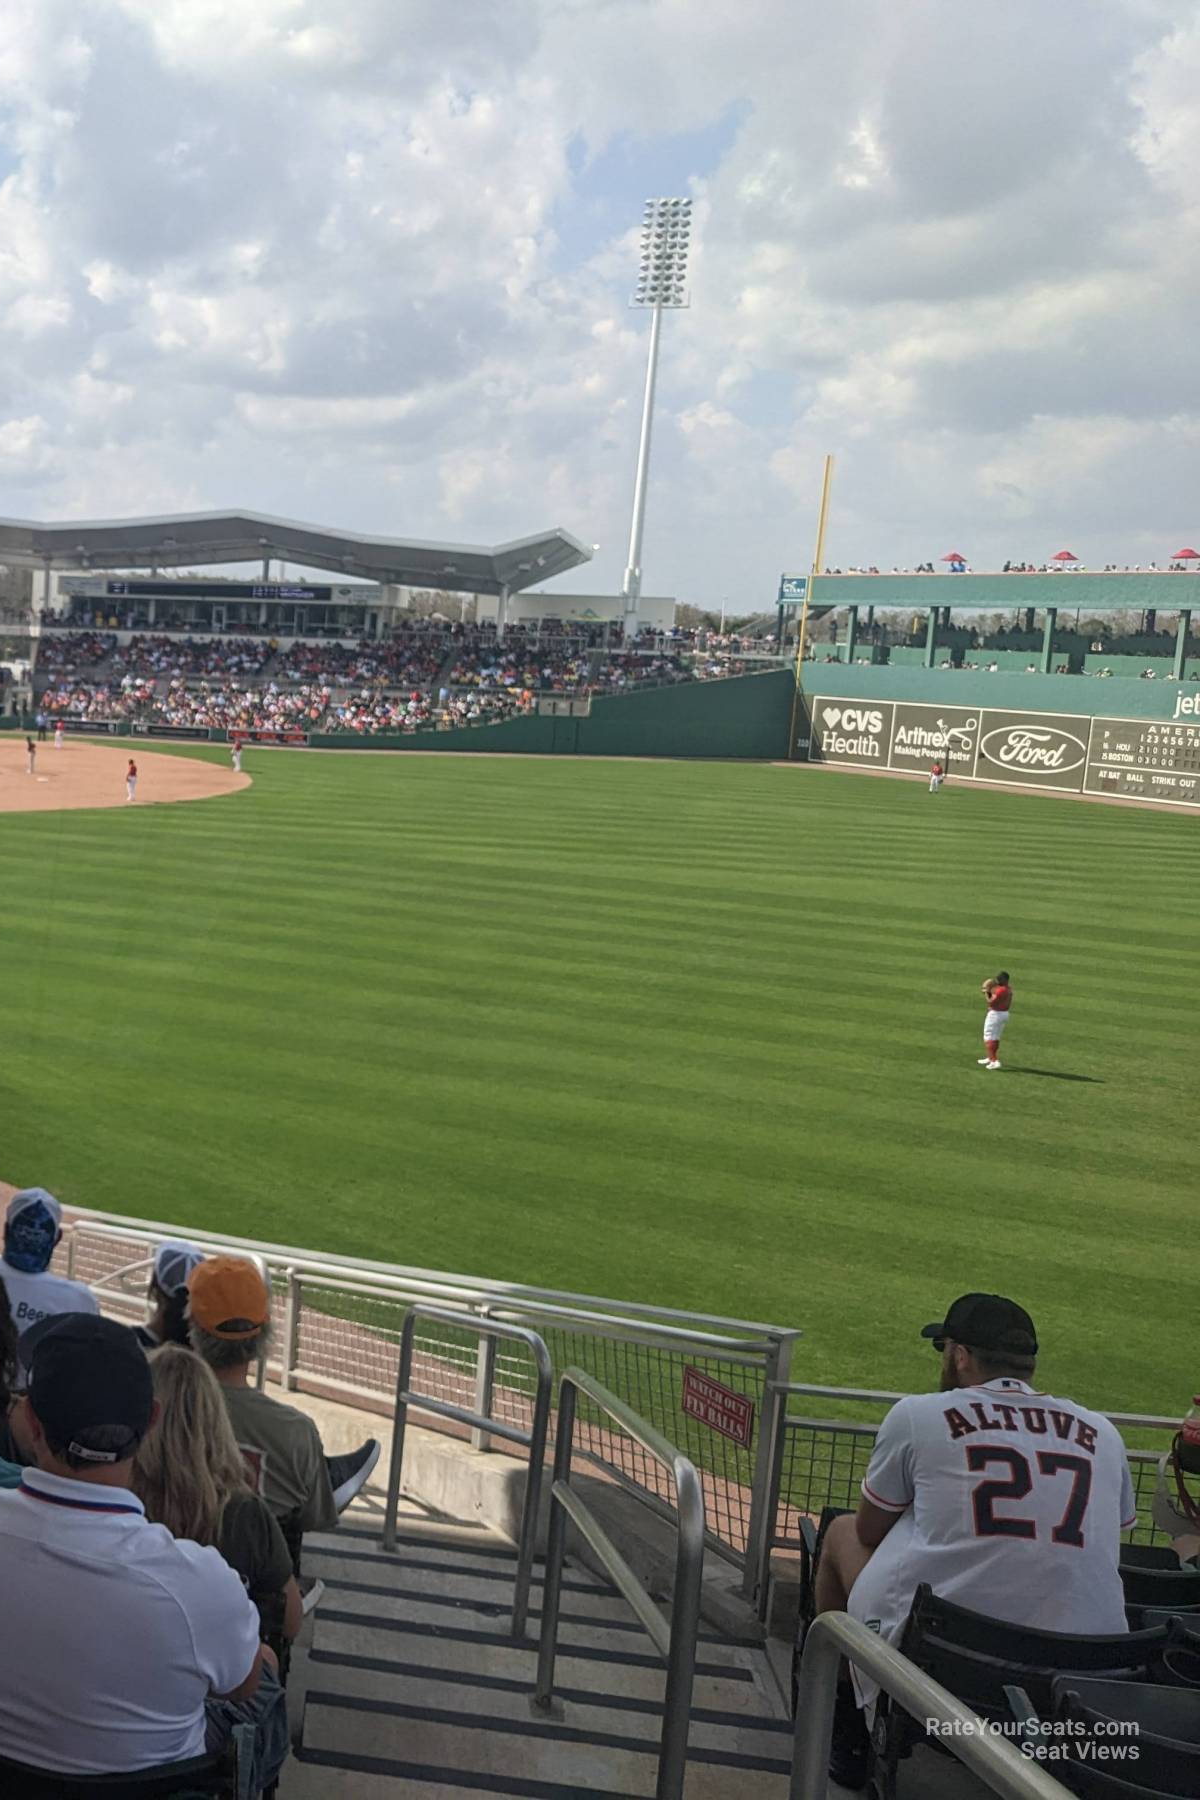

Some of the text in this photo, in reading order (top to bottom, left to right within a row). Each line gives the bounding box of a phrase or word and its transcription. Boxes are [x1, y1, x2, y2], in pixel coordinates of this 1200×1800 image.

[841, 709, 883, 733] CVS
[821, 731, 880, 757] Health
[894, 724, 952, 748] Arthrex
[999, 730, 1067, 767] Ford
[894, 745, 920, 758] Making
[921, 749, 946, 760] People
[1108, 752, 1134, 762] BOSTON
[1098, 770, 1197, 788] AT BAT BALL STRIKE OUT
[688, 1376, 723, 1404] WATCH
[724, 1397, 746, 1416] OUT
[687, 1395, 704, 1417] FLY
[707, 1405, 744, 1439] BALLS
[943, 1402, 1098, 1455] ALTUVE
[965, 1444, 1093, 1548] 27
